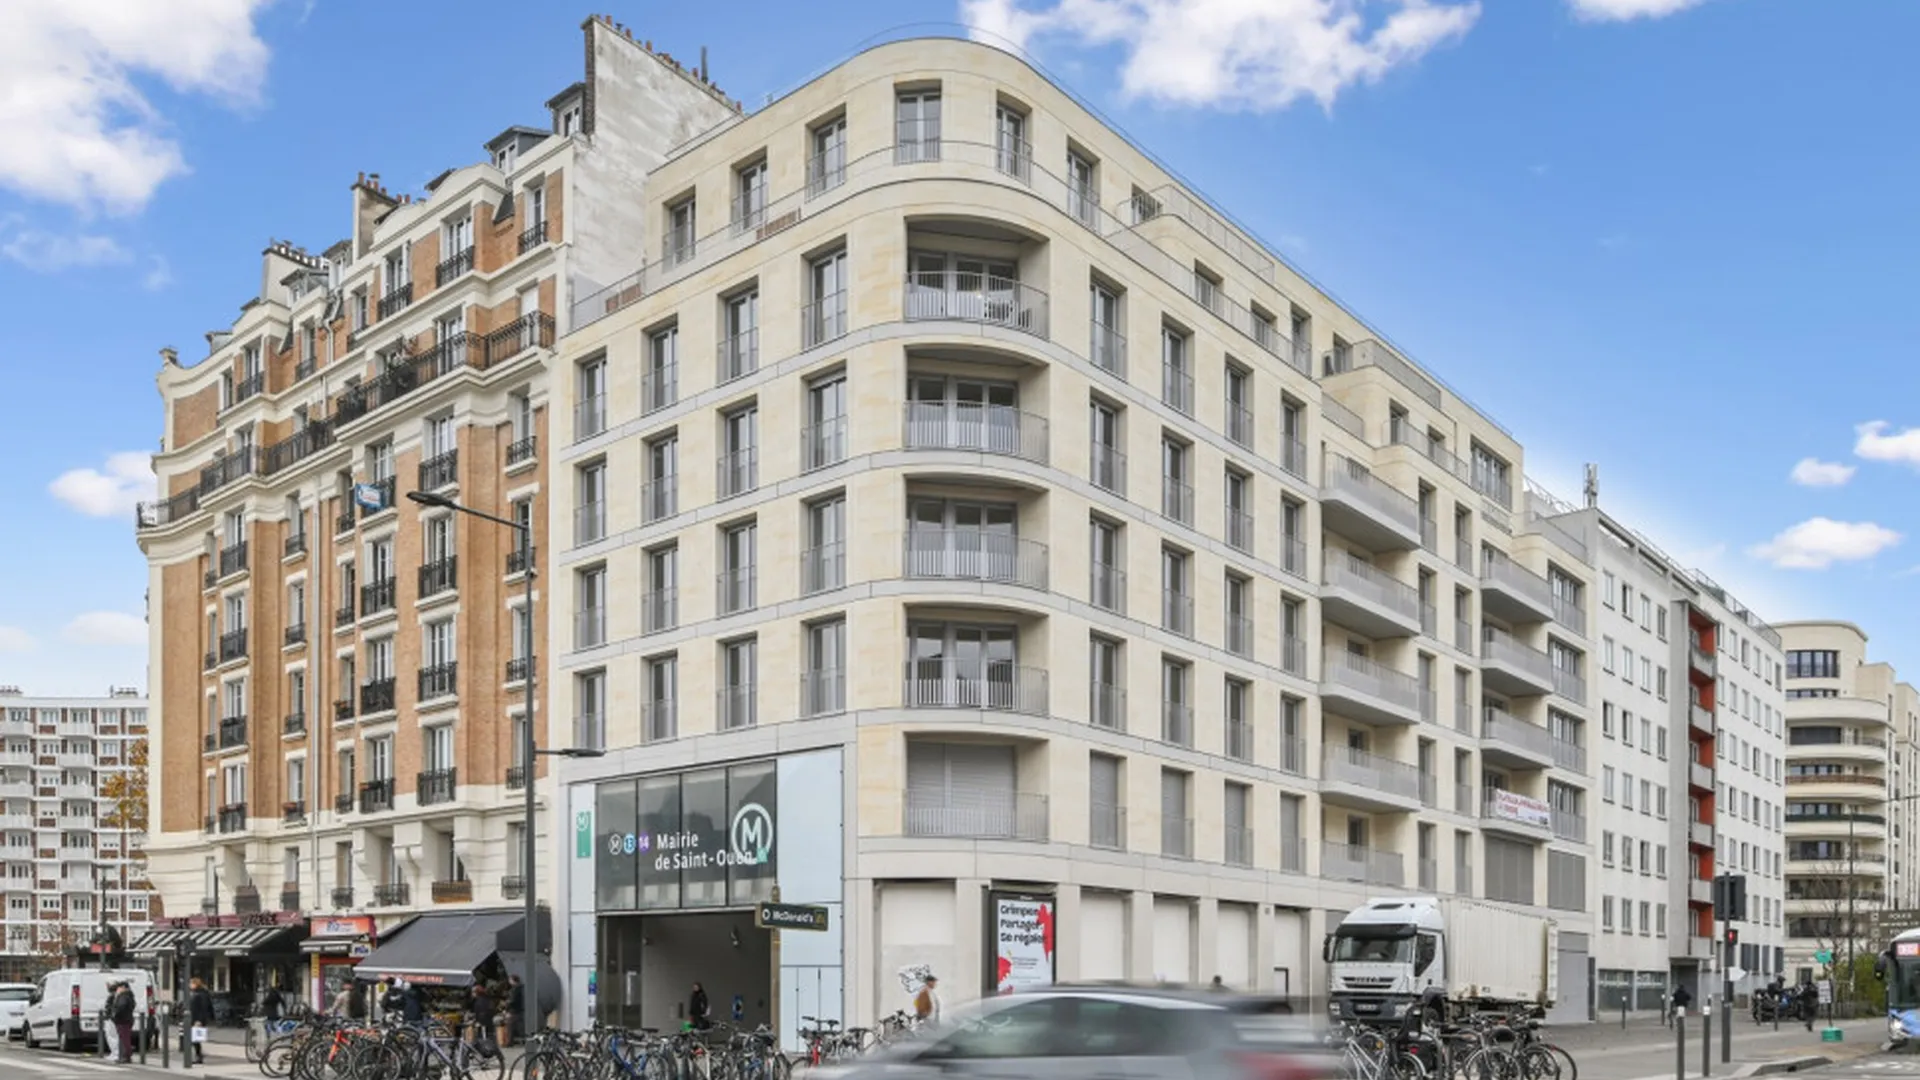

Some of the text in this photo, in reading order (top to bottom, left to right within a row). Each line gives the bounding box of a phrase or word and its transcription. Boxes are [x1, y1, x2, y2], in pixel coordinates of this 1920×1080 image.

[639, 836, 649, 848] 14
[656, 831, 698, 849] Mairie
[655, 855, 670, 870] de
[772, 911, 814, 922] McDonald's
[1000, 933, 1012, 942] Se
